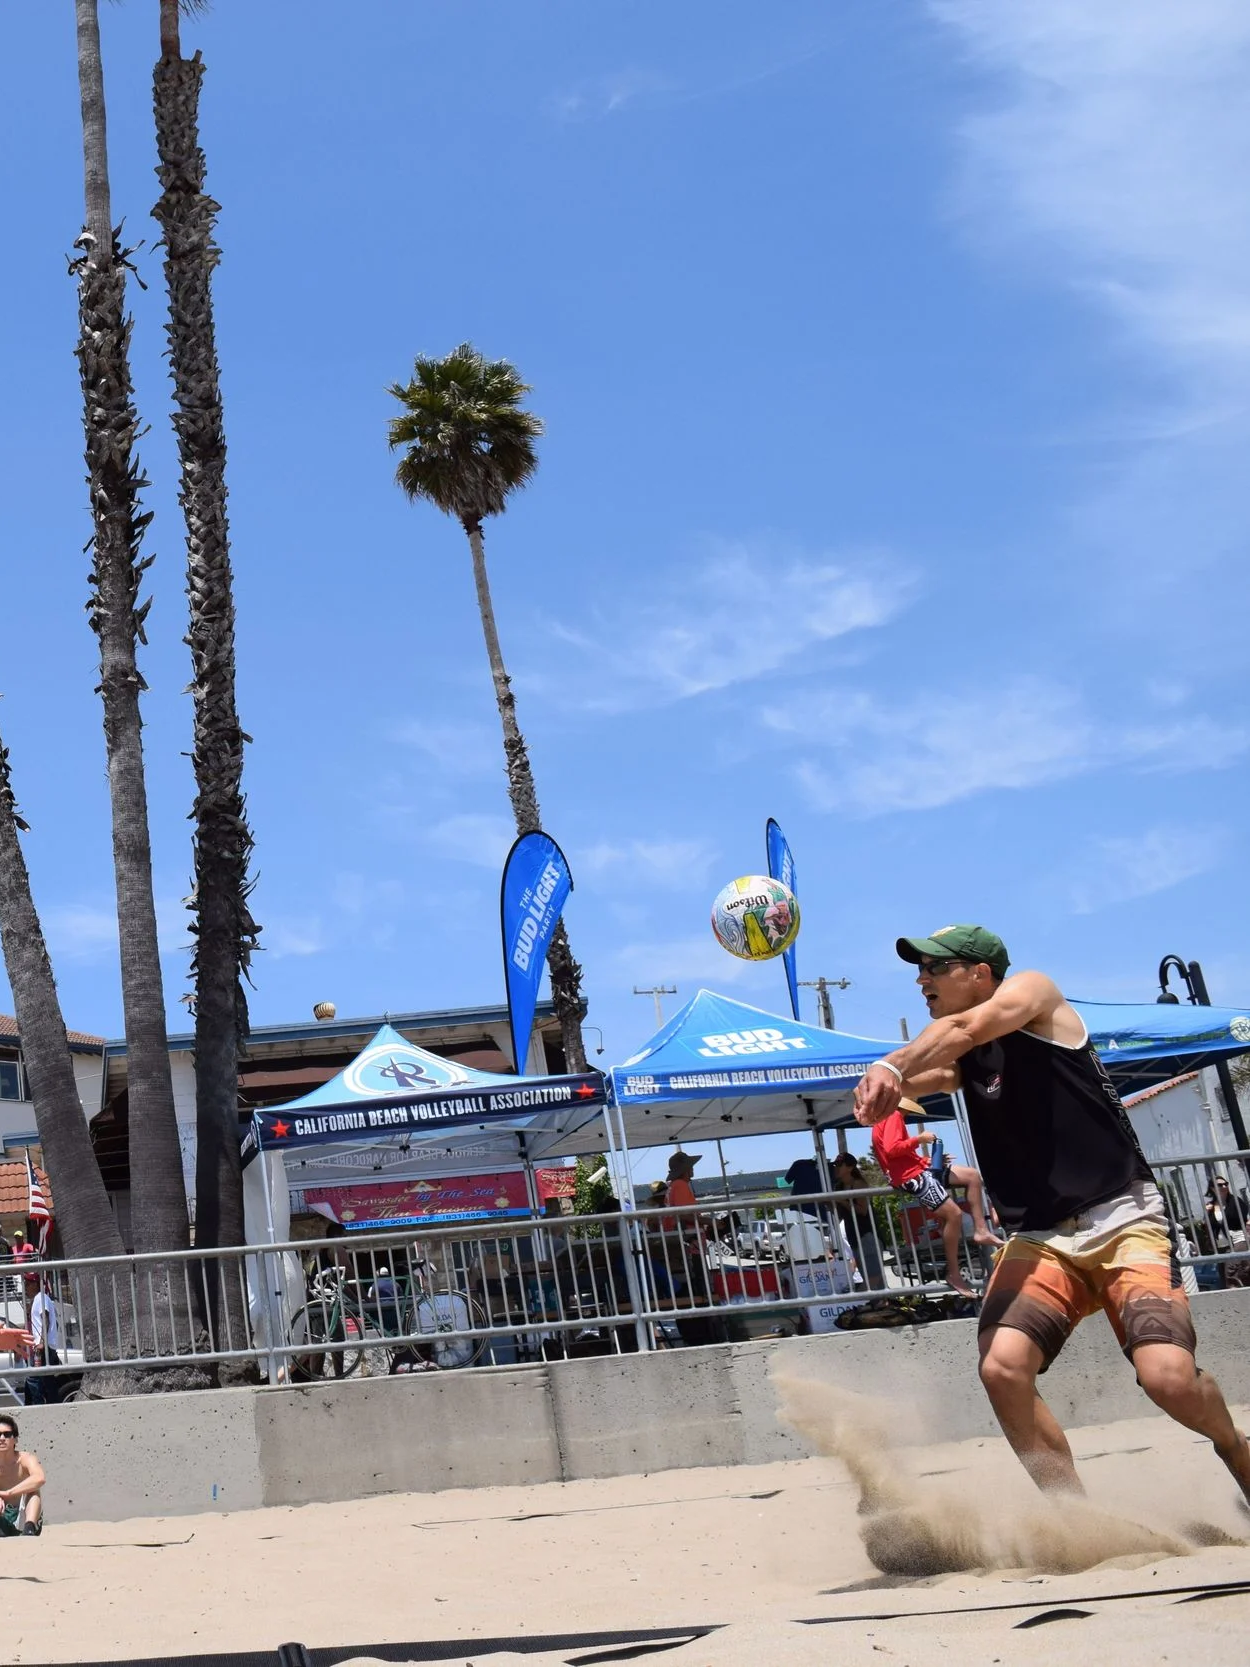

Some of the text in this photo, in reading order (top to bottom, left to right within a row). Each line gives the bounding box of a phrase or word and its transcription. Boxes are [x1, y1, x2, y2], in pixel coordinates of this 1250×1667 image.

[519, 887, 533, 910] THE
[726, 894, 769, 911] Wilson
[513, 861, 561, 972] BUD LIGHT
[539, 904, 556, 940] PARTY
[701, 1028, 784, 1048] BUD
[626, 1075, 655, 1086] BUD
[669, 1070, 731, 1090] CALIFORNIA
[732, 1066, 767, 1086] BEACH
[766, 1064, 826, 1084] VOLLEYBALL
[623, 1084, 661, 1096] LIGHT
[294, 1085, 572, 1137] CALIFORNIA BEACH VOLLEYBALL ASSOCIATION
[438, 1190, 464, 1200] The
[468, 1187, 495, 1198] Sea
[367, 1201, 486, 1219] Thai Cuisine
